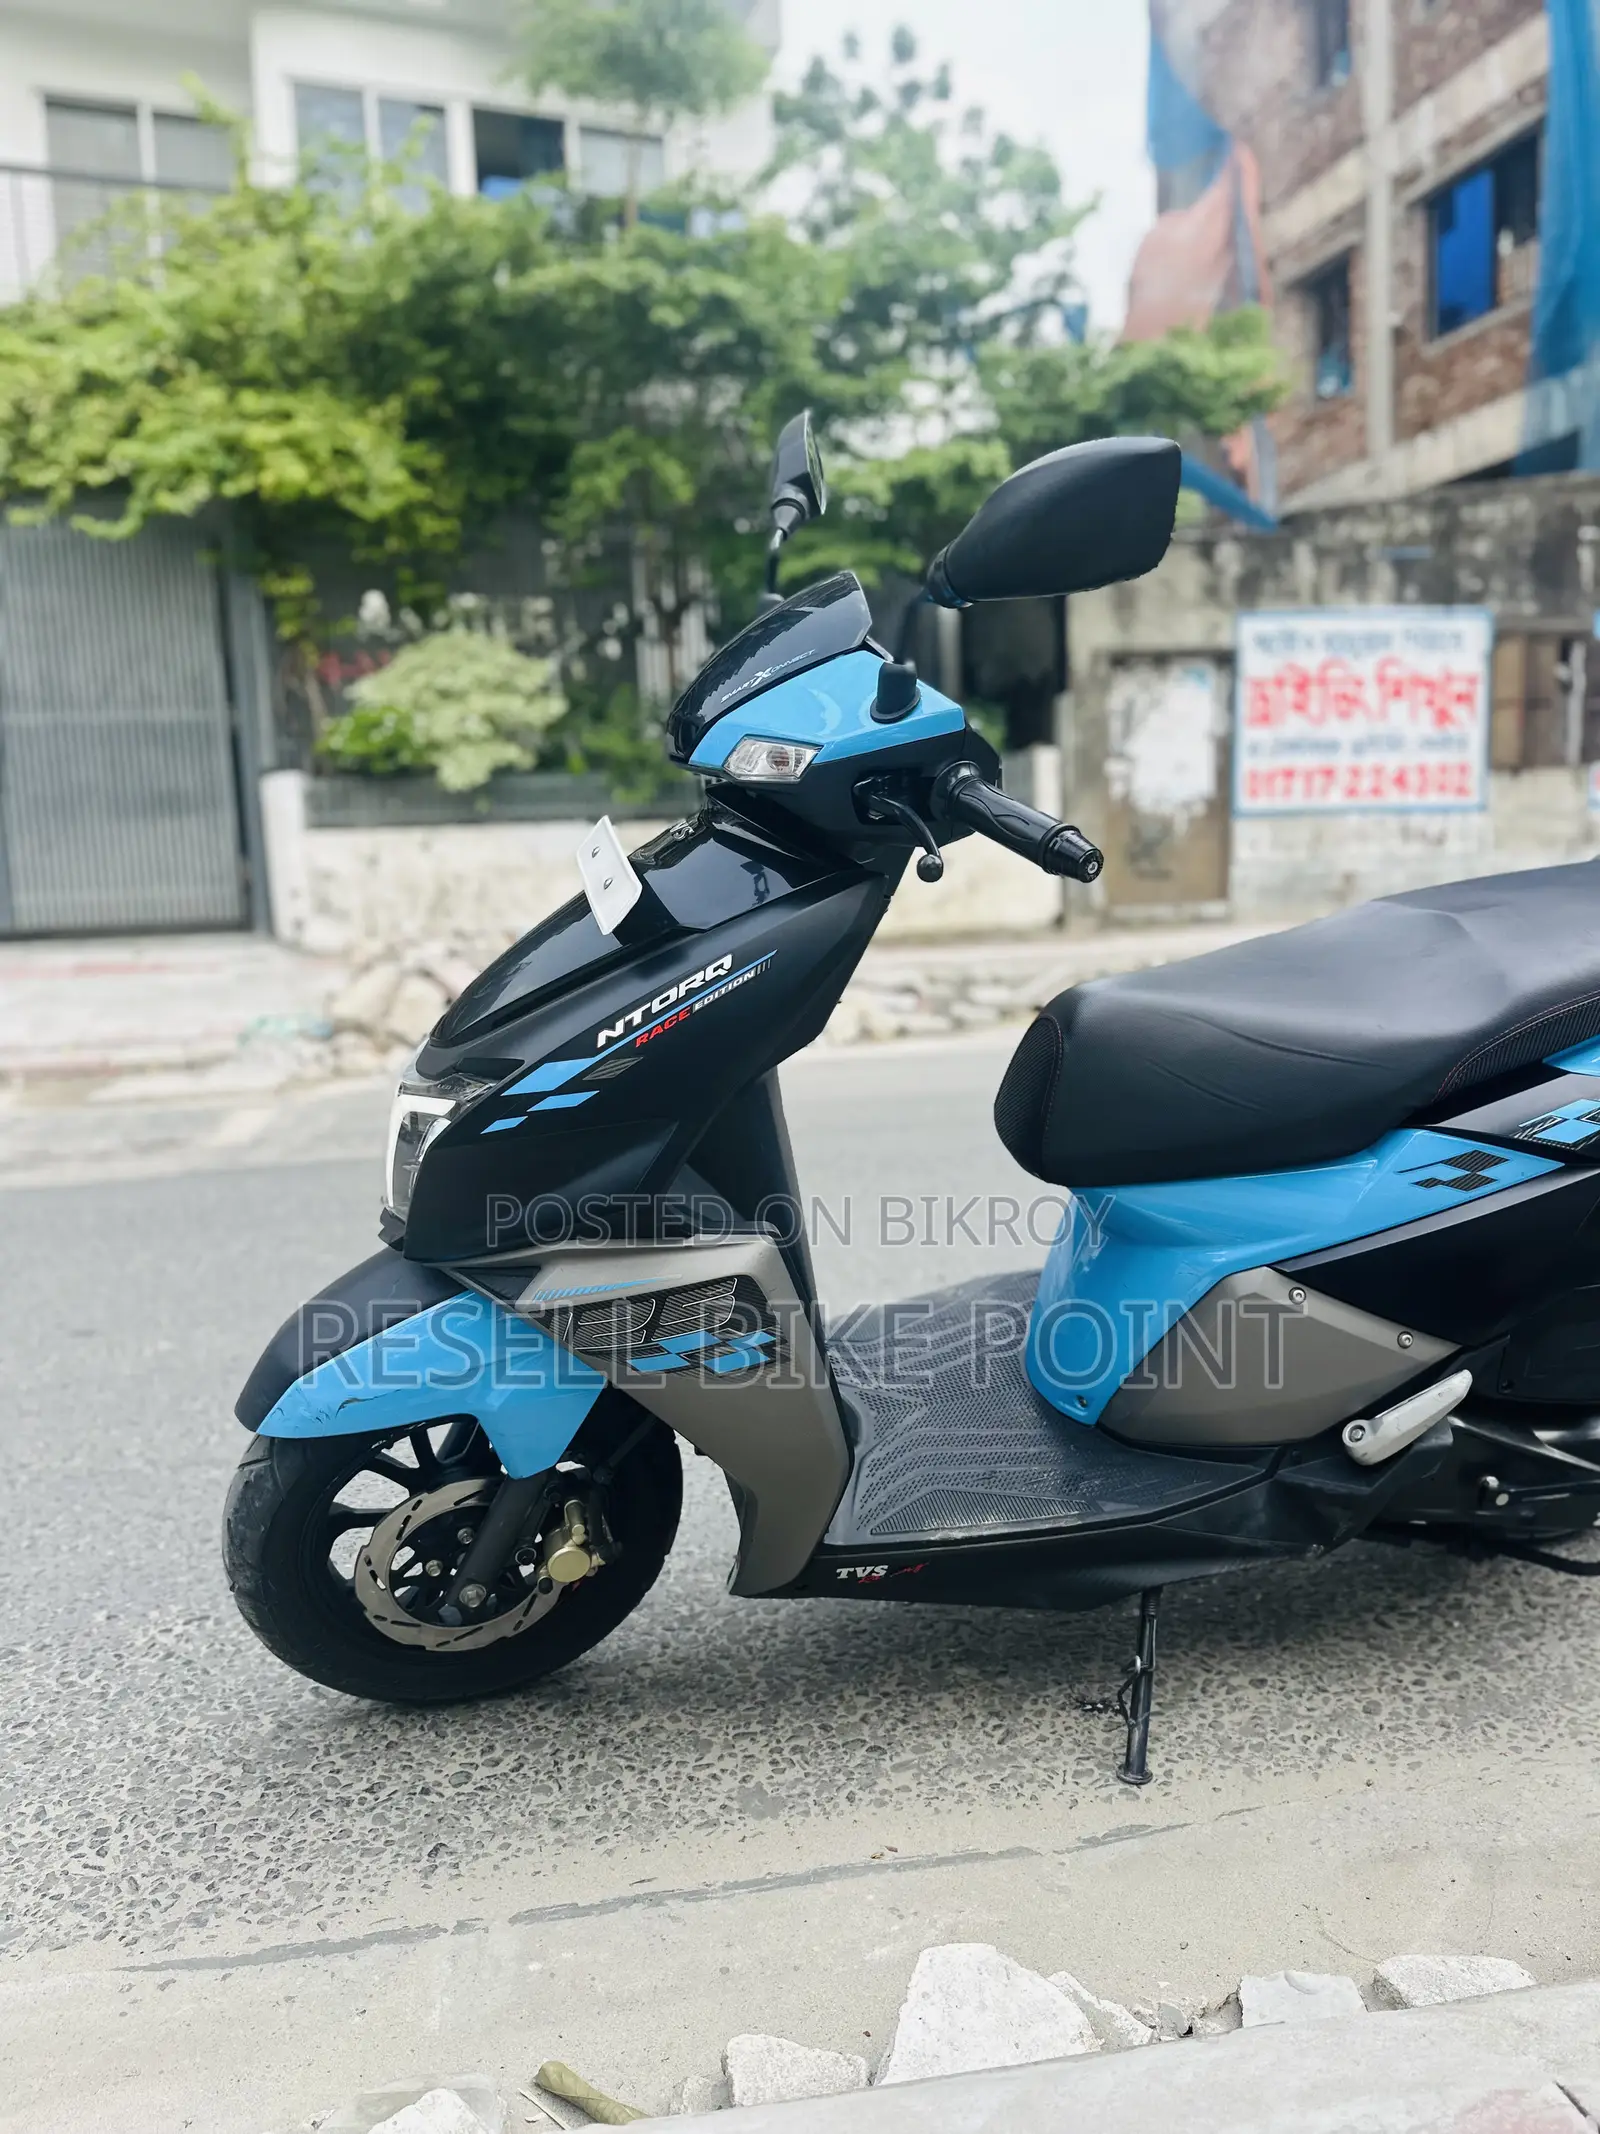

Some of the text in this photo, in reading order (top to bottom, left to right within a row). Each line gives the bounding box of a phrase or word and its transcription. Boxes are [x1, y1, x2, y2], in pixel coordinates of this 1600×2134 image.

[597, 953, 734, 1048] NTORQ
[635, 967, 757, 1048] RACE EDITION
[836, 1565, 889, 1580] TVS
